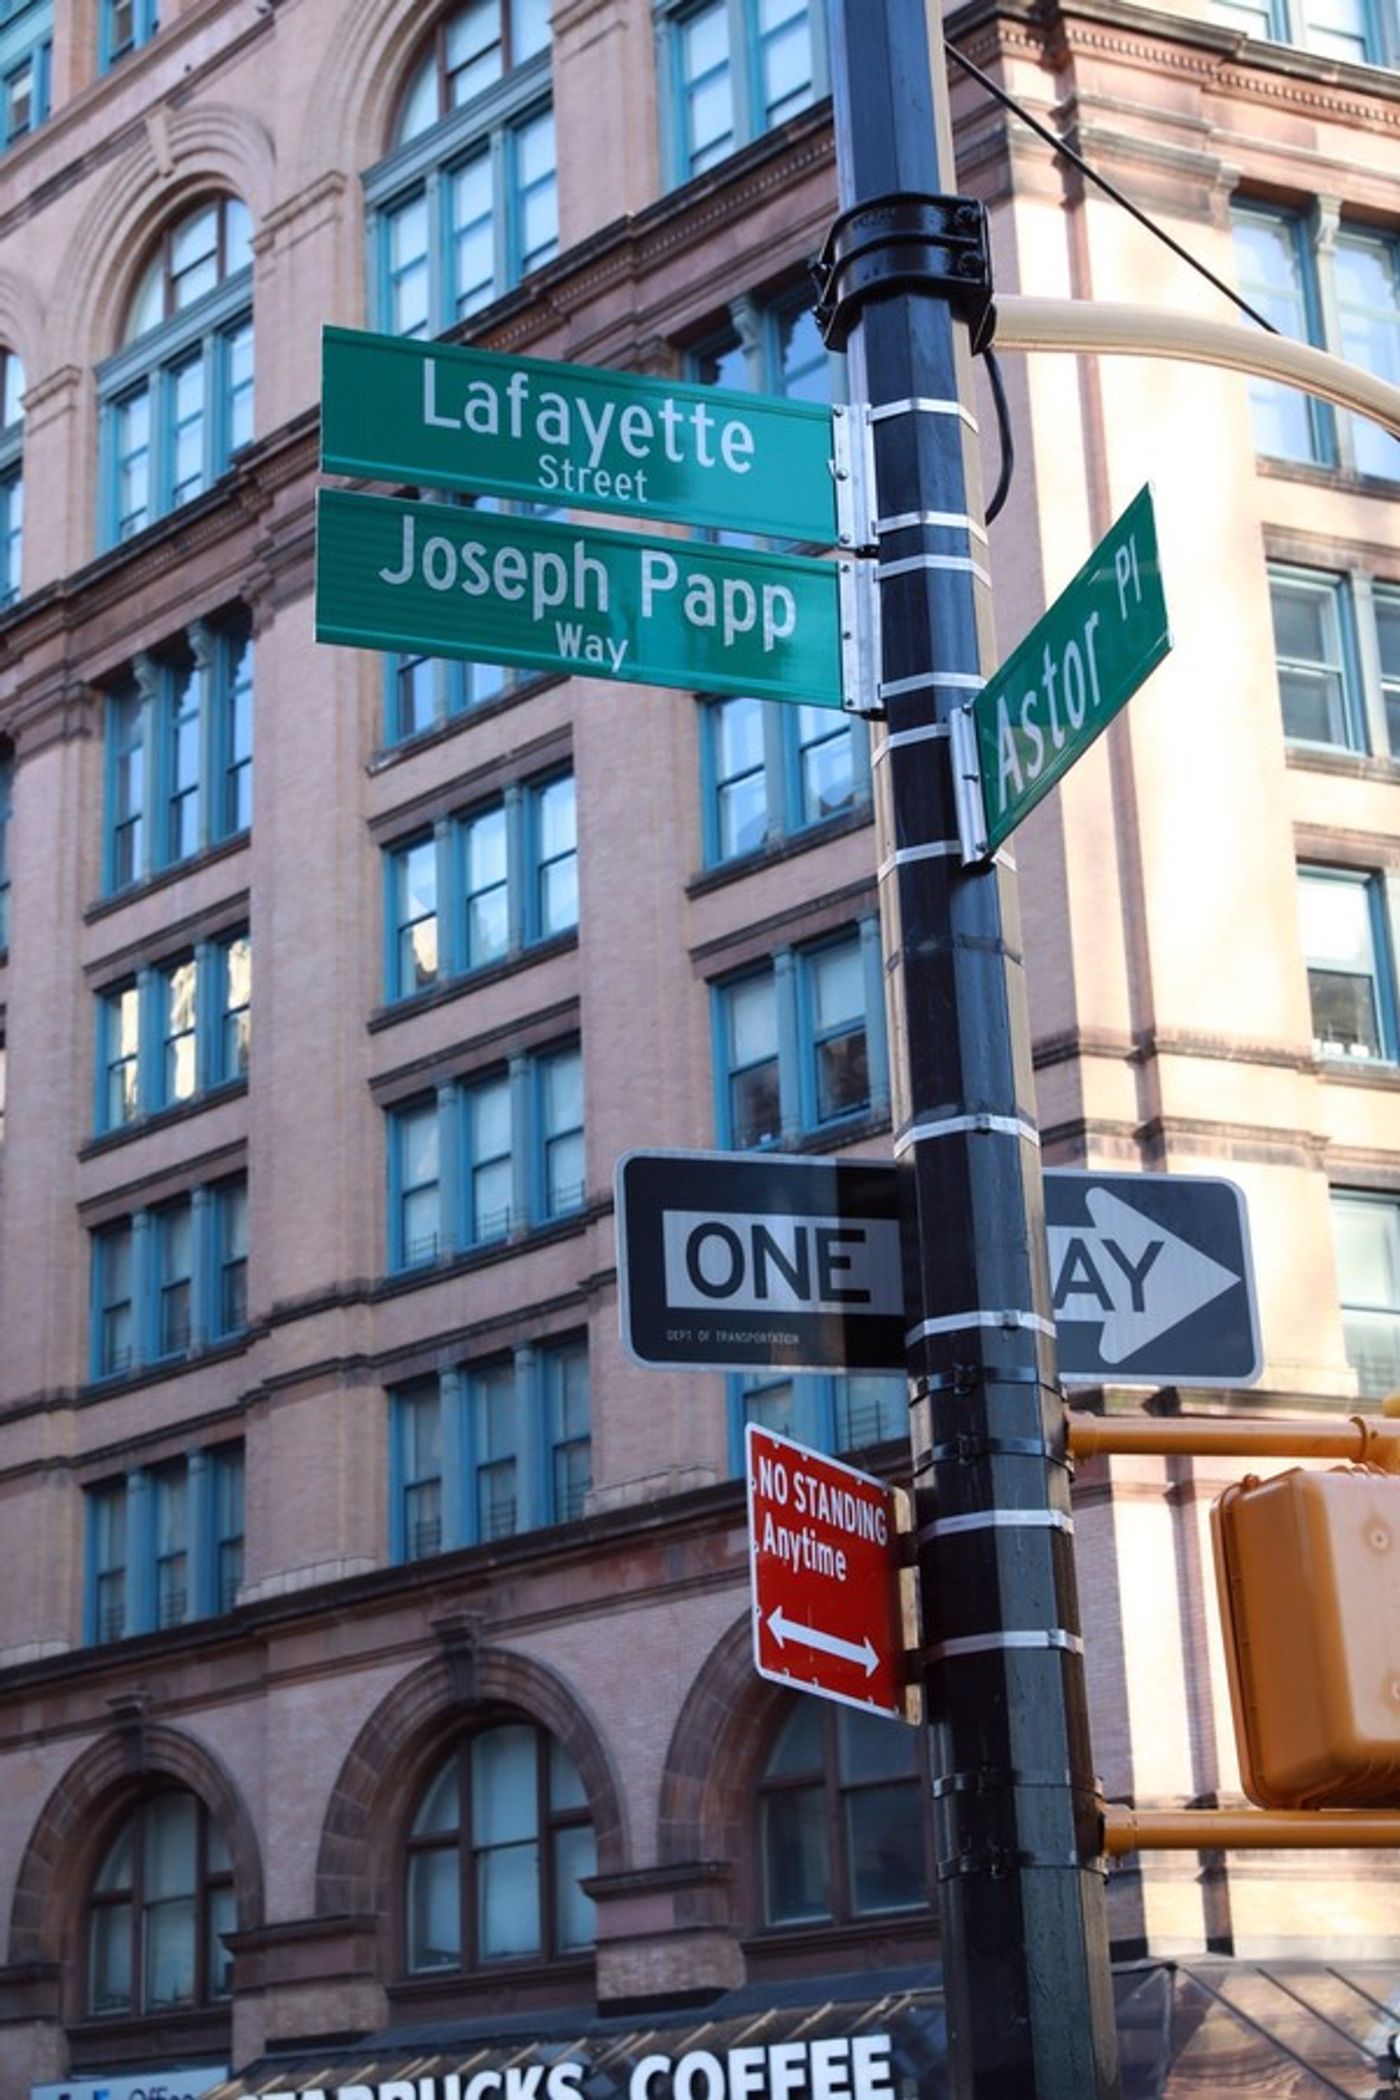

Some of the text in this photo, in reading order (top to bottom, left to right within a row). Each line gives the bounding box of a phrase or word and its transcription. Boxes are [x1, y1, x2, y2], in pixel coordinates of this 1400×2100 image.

[423, 358, 755, 473] Lafayette
[538, 454, 648, 503] Street
[379, 515, 797, 653] Joseph Papp
[555, 621, 629, 674] Way
[996, 533, 1142, 812] Astor Pl
[685, 1221, 1165, 1313] ONE AY
[758, 1456, 888, 1547] NO STANDING
[763, 1512, 848, 1582] Anytime
[629, 2033, 895, 2100] COFFEE
